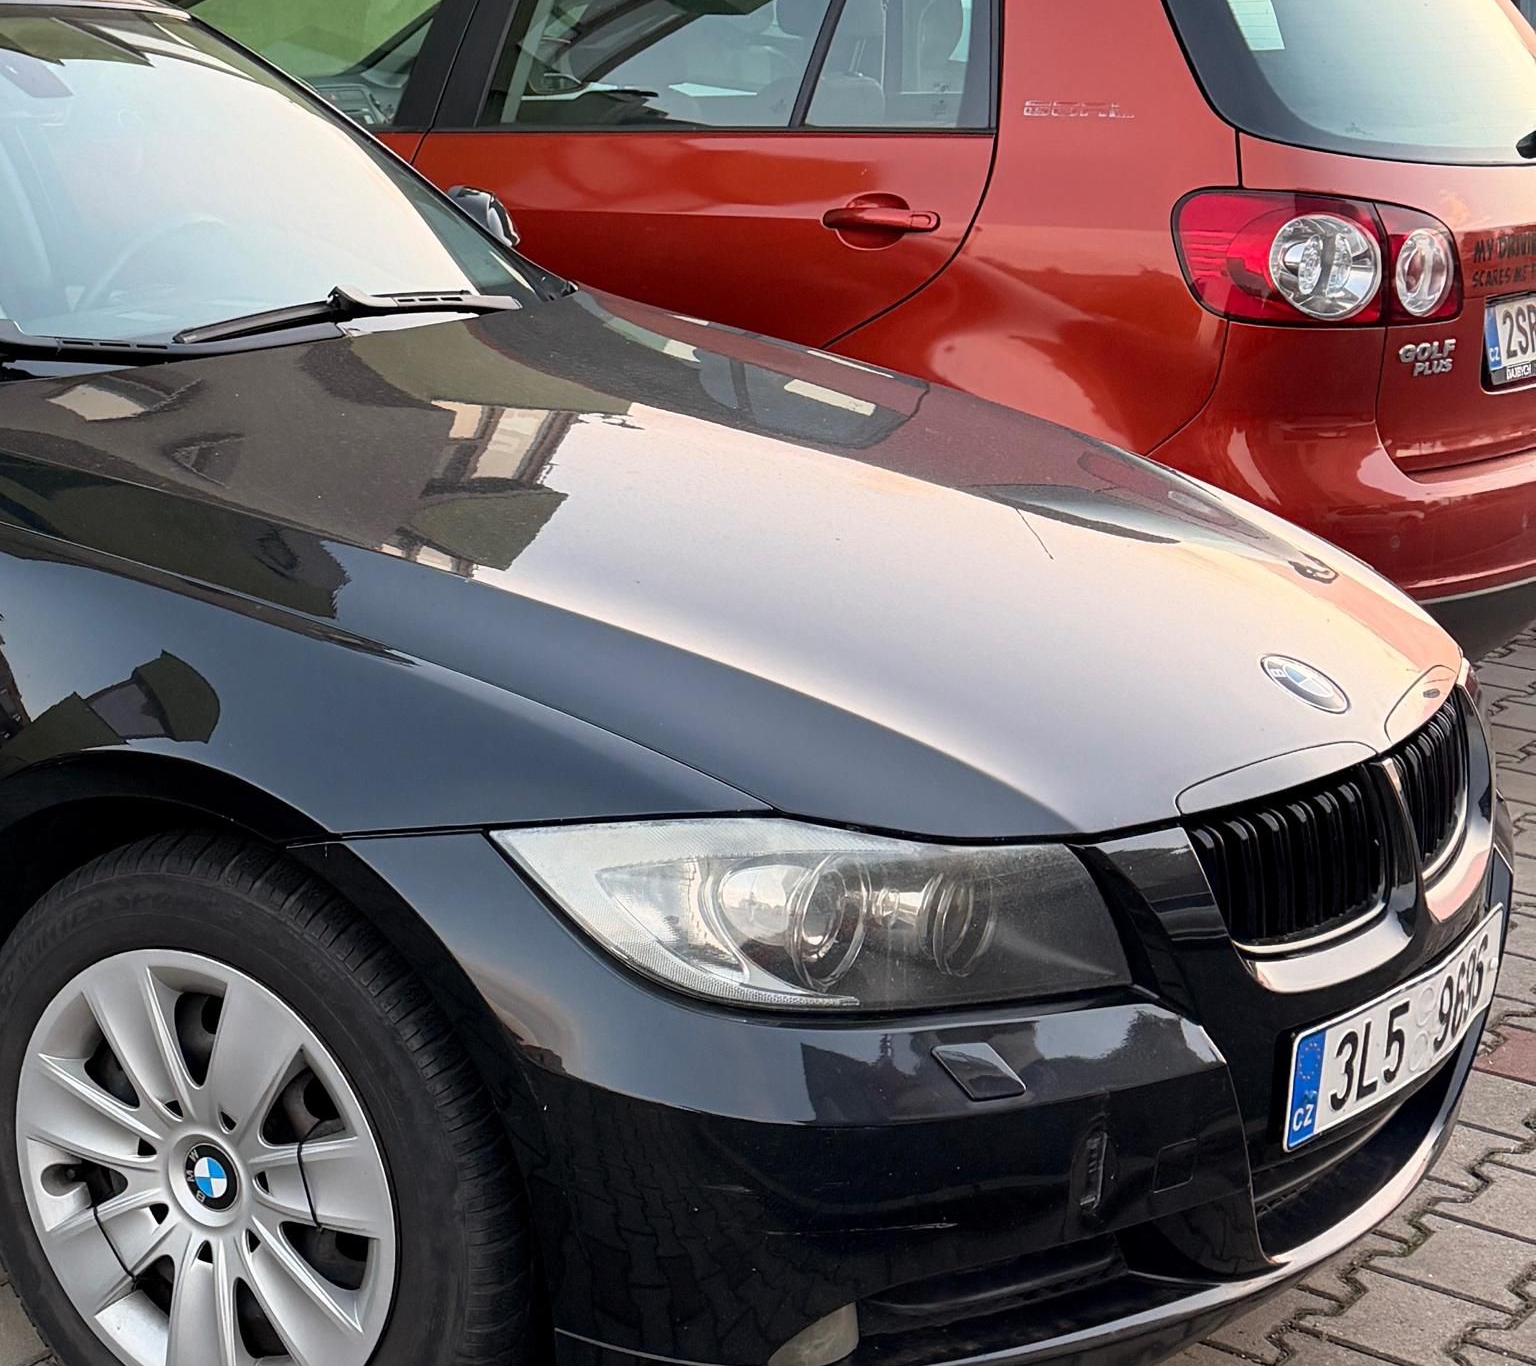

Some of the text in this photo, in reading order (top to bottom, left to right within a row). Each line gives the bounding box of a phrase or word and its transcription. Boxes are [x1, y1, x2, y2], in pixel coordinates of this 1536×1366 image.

[1473, 237, 1494, 263] MY
[1472, 266, 1511, 288] SCARES
[1398, 338, 1457, 363] GOLF
[1489, 346, 1500, 362] CZ
[1413, 358, 1454, 377] PLUS
[1329, 1000, 1411, 1112] 3L5
[1292, 1103, 1315, 1132] CZ
